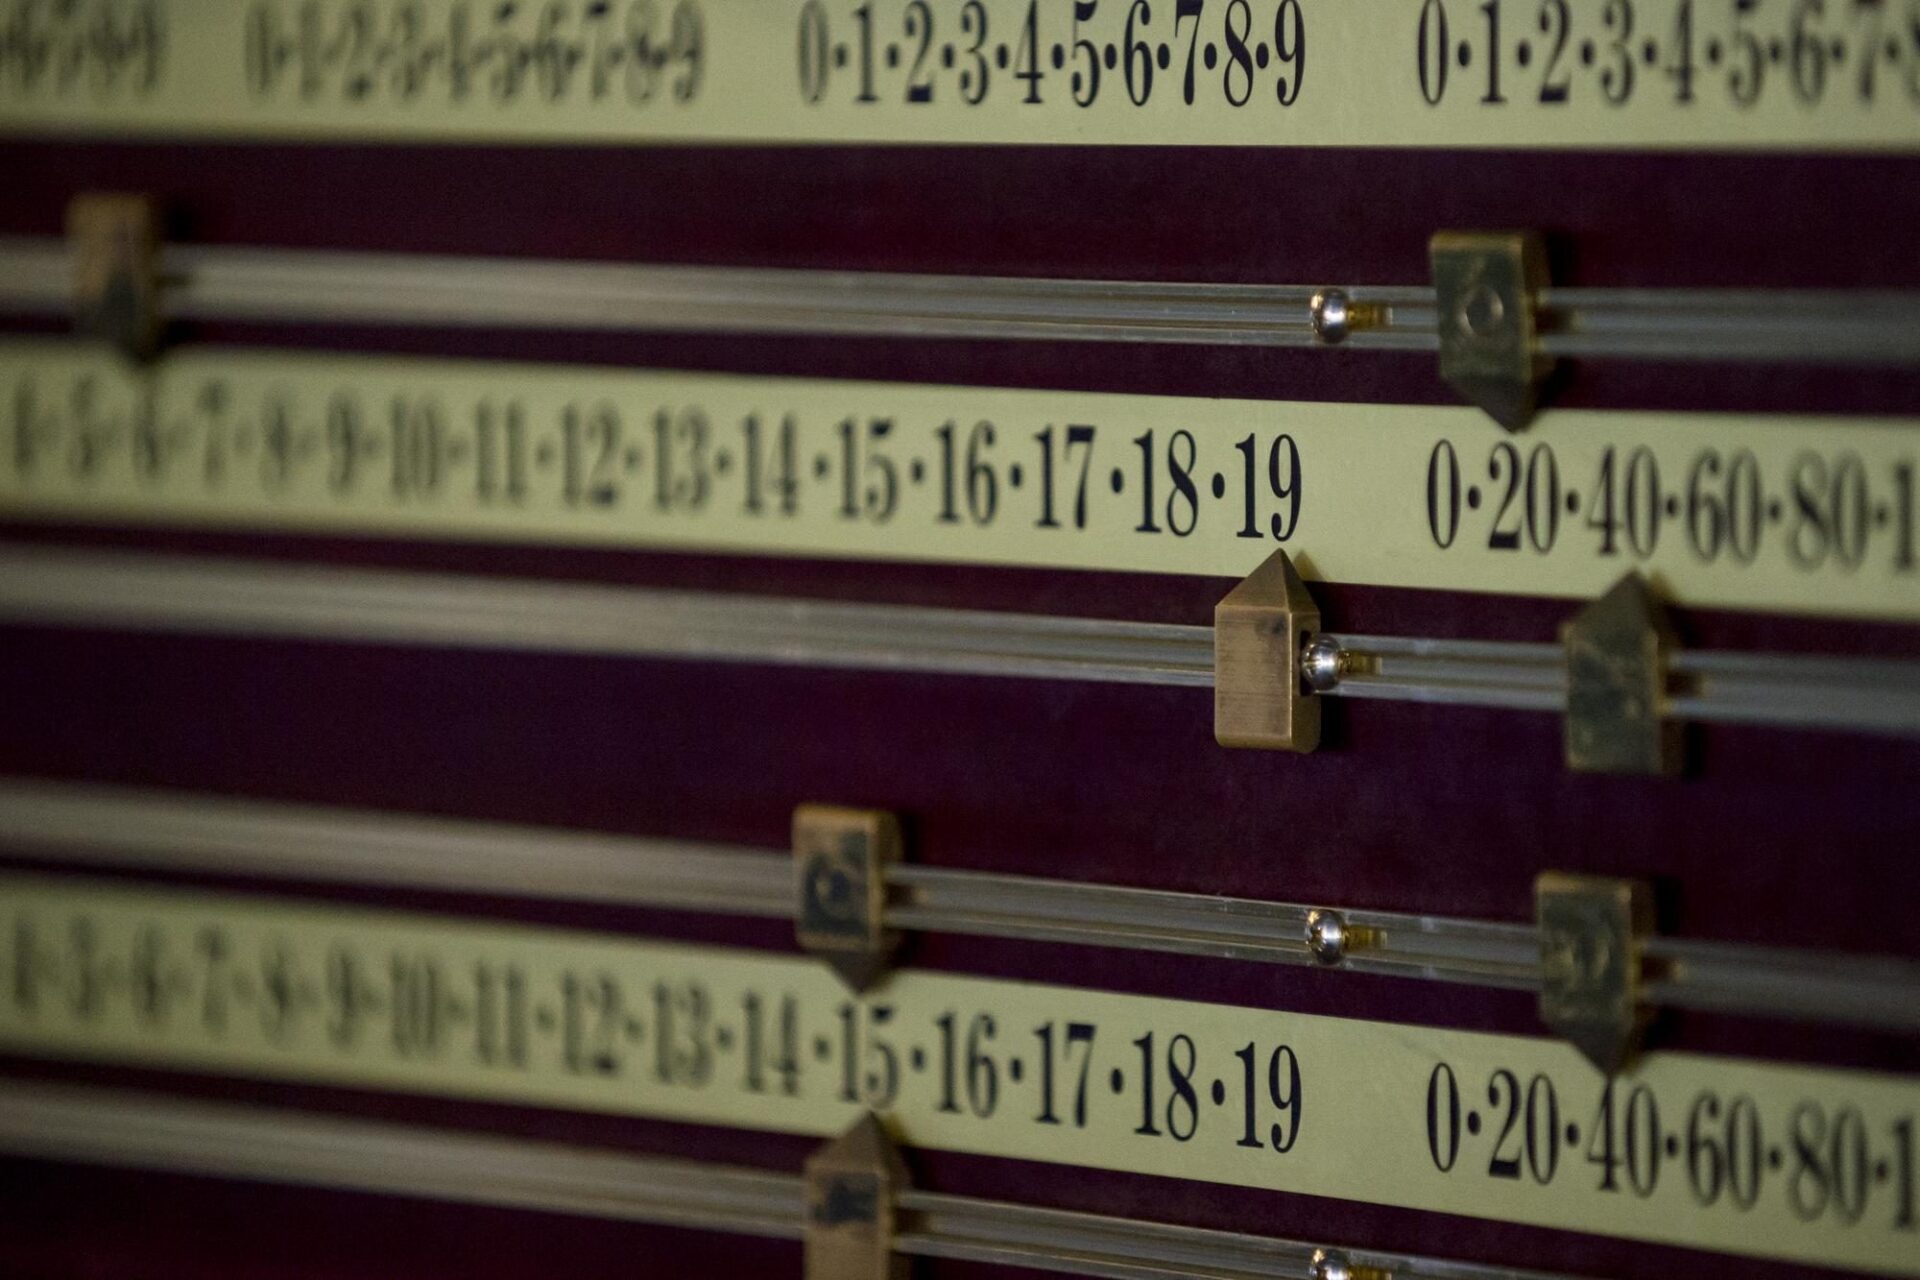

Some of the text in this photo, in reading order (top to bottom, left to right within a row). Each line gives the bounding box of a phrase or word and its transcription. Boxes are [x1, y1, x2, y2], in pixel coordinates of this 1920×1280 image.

[853, 0, 877, 102] 1
[904, 0, 933, 103] 2
[960, 0, 988, 104] 3
[1015, 0, 1044, 104] 4
[1071, 0, 1100, 107] 5
[1124, 0, 1153, 106] 6
[1174, 0, 1200, 106] 7
[1223, 0, 1254, 107] 8
[1274, 0, 1305, 107] 9
[1418, 0, 1449, 105] 0
[1480, 0, 1507, 103] 1
[1539, 0, 1571, 103] 2
[1600, 0, 1633, 107] 3
[1664, 0, 1696, 103] 4
[1730, 0, 1765, 110] 5
[652, 403, 710, 516] 13
[744, 407, 799, 518] 14
[840, 415, 898, 523] 15
[936, 421, 998, 527] 16
[1034, 425, 1096, 528] 17
[1133, 428, 1198, 537] 18
[1235, 433, 1301, 542] 19
[1427, 439, 1461, 549] 0
[1488, 441, 1560, 552] 20
[1588, 444, 1661, 558] 40
[1686, 448, 1763, 564] 60
[1788, 449, 1870, 570] 80
[744, 992, 799, 1095] 14
[840, 1003, 898, 1109] 15
[936, 1012, 998, 1117] 16
[1034, 1022, 1096, 1127] 17
[1133, 1032, 1198, 1141] 18
[1235, 1042, 1301, 1153] 19
[1427, 1062, 1460, 1172] 0
[1488, 1069, 1559, 1185] 20
[1587, 1074, 1660, 1197] 40
[1686, 1092, 1763, 1211] 60
[1788, 1101, 1870, 1226] 80
